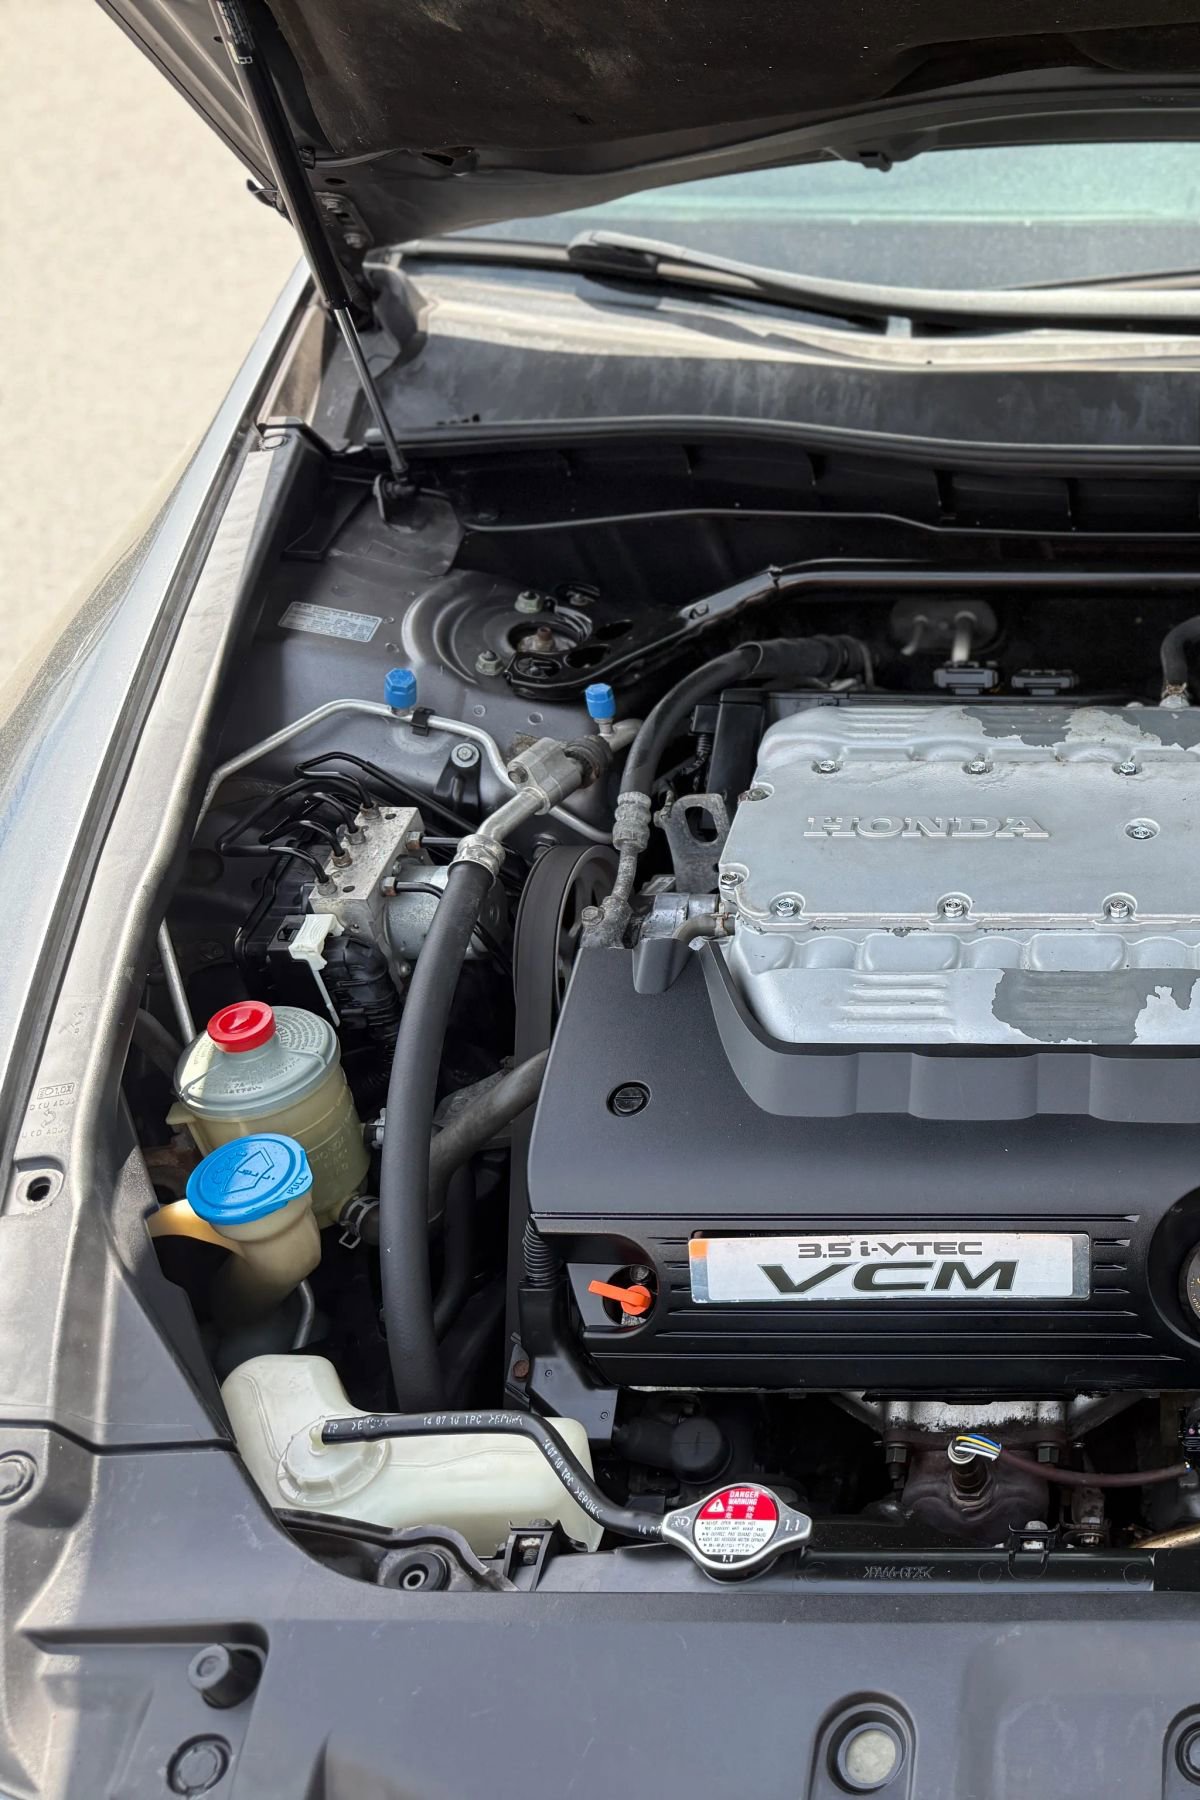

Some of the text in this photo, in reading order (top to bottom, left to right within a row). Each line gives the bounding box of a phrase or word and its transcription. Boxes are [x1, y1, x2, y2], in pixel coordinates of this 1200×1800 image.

[804, 816, 1049, 838] HONDA
[286, 1175, 310, 1194] PULL
[798, 1242, 850, 1258] 3.5
[757, 1260, 1019, 1295] VCM
[424, 1417, 433, 1426] 14
[436, 1416, 446, 1425] 07
[450, 1416, 459, 1426] 10
[465, 1415, 482, 1425] TPC
[548, 1446, 558, 1458] 07
[554, 1456, 562, 1469] 10
[561, 1468, 575, 1487] TPC
[573, 1486, 604, 1518] >EPDM<
[784, 1520, 800, 1532] 1.1
